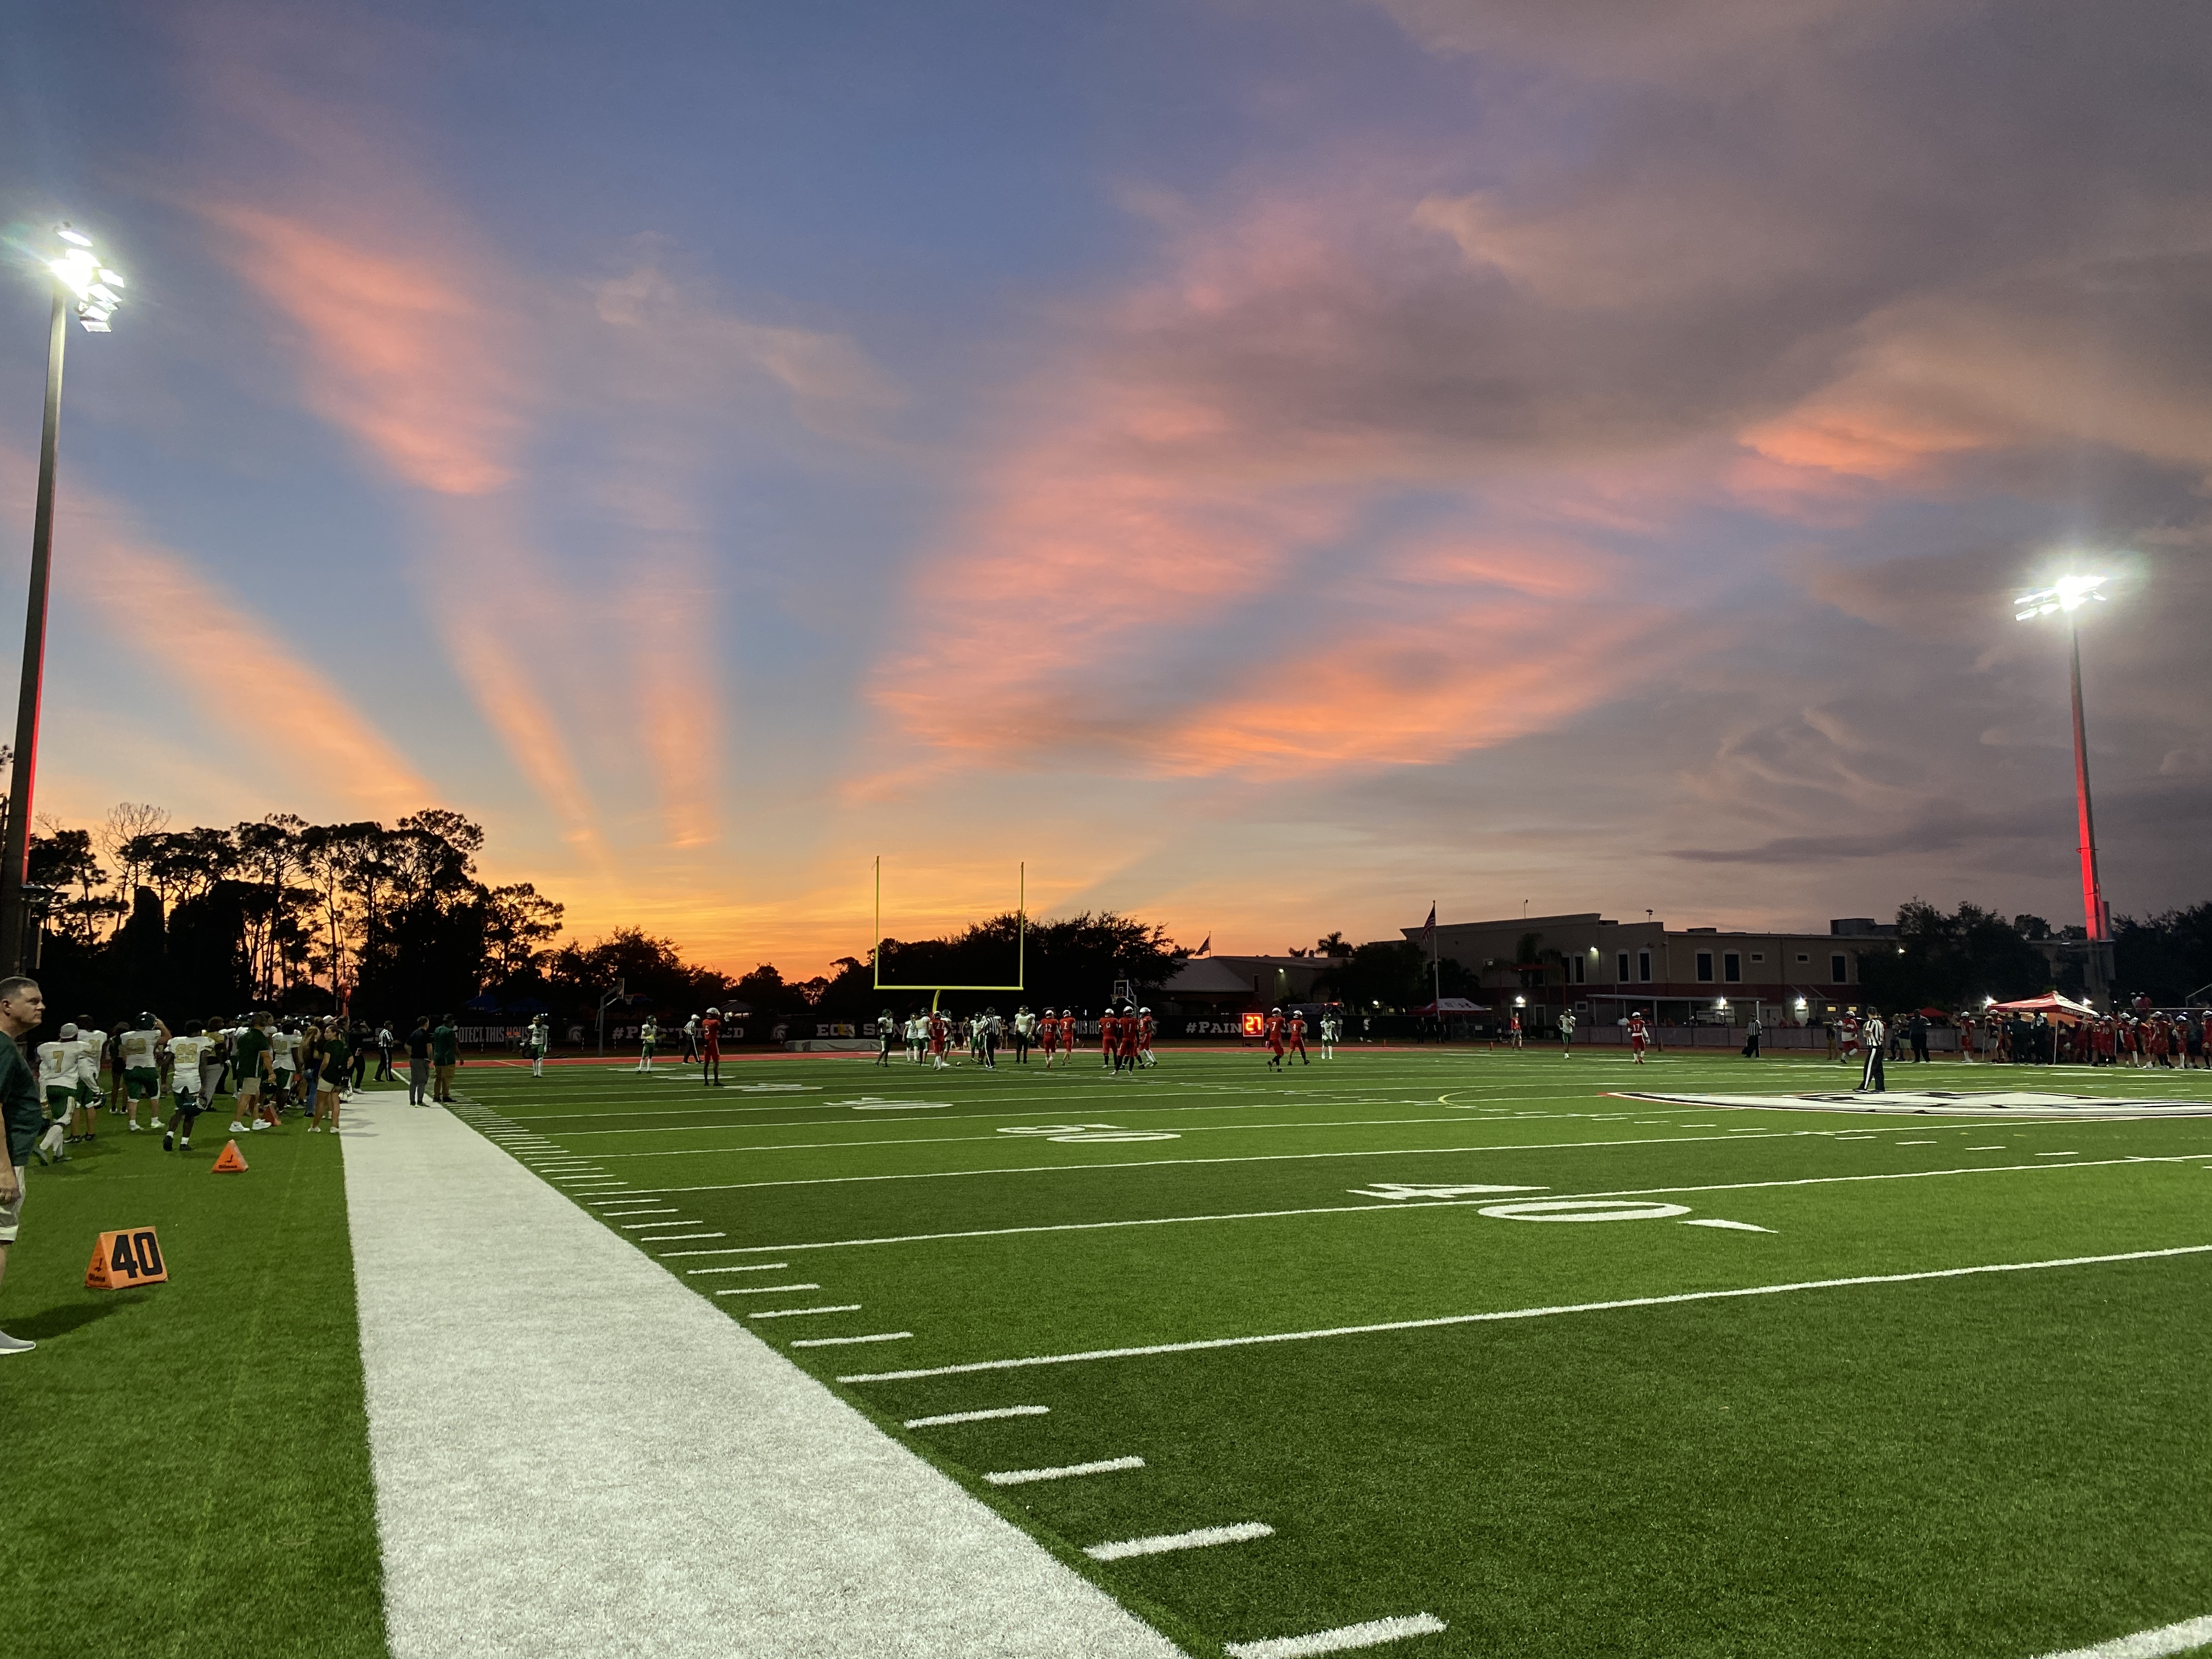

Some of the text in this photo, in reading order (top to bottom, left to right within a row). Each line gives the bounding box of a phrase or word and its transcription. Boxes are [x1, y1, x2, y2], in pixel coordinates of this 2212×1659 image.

[1045, 1023, 1052, 1032] 12
[1063, 1022, 1068, 1030] 2
[1128, 1023, 1132, 1032] 1
[1245, 1016, 1261, 1031] 27
[1272, 1022, 1276, 1031] 7
[486, 1026, 505, 1042] THIS
[705, 1025, 710, 1035] 5
[53, 1051, 64, 1073] 7
[1346, 1183, 1692, 1222] 40
[111, 1232, 163, 1279] 40
